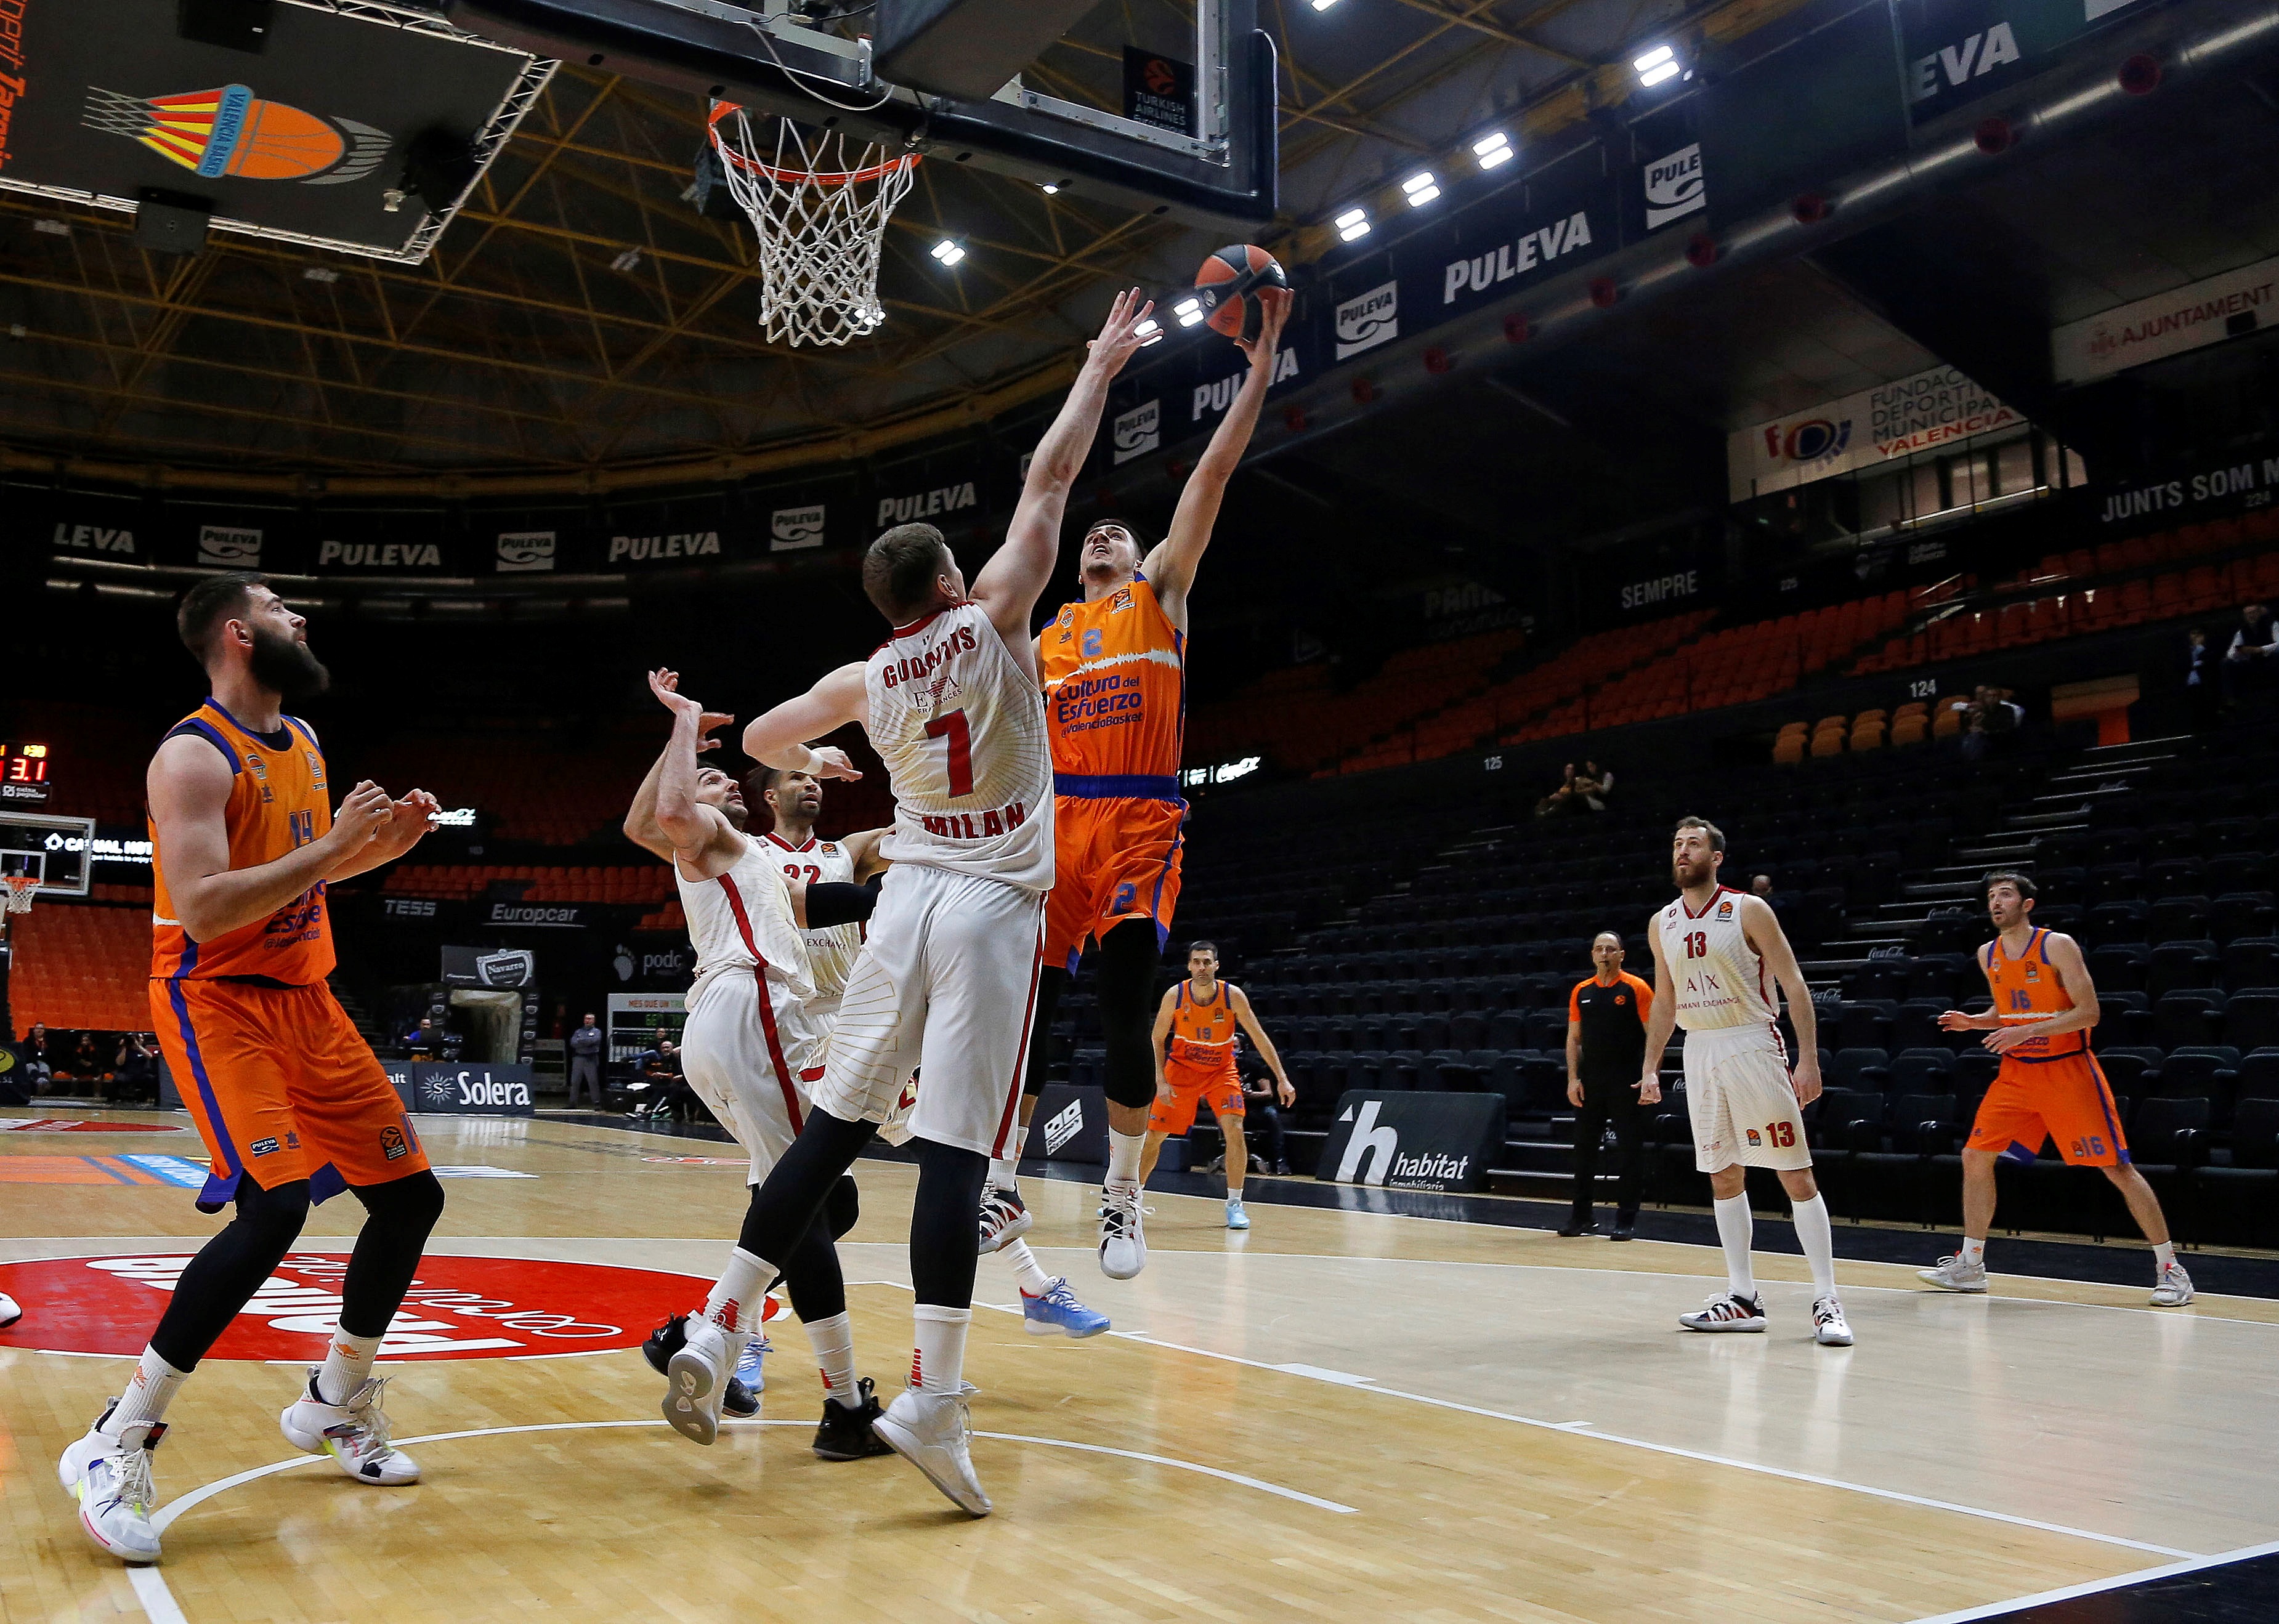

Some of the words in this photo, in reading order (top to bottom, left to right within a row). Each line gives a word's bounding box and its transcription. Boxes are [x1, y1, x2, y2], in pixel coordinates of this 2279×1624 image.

[1910, 21, 2020, 103] EVA
[1134, 103, 1187, 126] AIRLINES
[1135, 91, 1186, 115] TURKISH
[216, 94, 247, 142] VALENCIA
[1650, 153, 1699, 188] PULE
[1443, 210, 1592, 304] PULEVA
[1338, 291, 1393, 326] PULEVA
[2121, 283, 2273, 346] AJUNTAMENT
[1117, 407, 1157, 435] PULEVA
[1877, 408, 2013, 456] VALENCIA
[877, 482, 977, 527] PULEVA
[2101, 480, 2184, 522] JUNTS
[2191, 463, 2255, 501] SOM
[775, 513, 820, 527] PULEVA
[53, 522, 136, 554] LEVA
[204, 530, 257, 544] PULEVA
[501, 537, 551, 549] PULEVA
[609, 531, 721, 562] PULEVA
[318, 540, 442, 566] PULEVA
[1620, 569, 1700, 610] SEMPRE
[1082, 628, 1103, 658] 2
[1055, 674, 1120, 702] Cultura
[1122, 676, 1140, 688] del
[1910, 679, 1937, 699] 124
[1057, 692, 1143, 724] Esfuerzo
[1061, 712, 1144, 738] @ValenciaBasket
[924, 707, 973, 798] 7
[921, 801, 1026, 839] MILAN
[385, 900, 437, 916] TESS
[1111, 881, 1136, 916] 2
[491, 903, 579, 924] Europcar
[1683, 931, 1707, 959] 13
[2010, 989, 2031, 1010] 16
[456, 1071, 531, 1106] Solera
[252, 1137, 276, 1150] PULEVA
[1766, 1121, 1795, 1149] 13
[2081, 1136, 2106, 1157] 16
[1393, 1152, 1468, 1180] habitat
